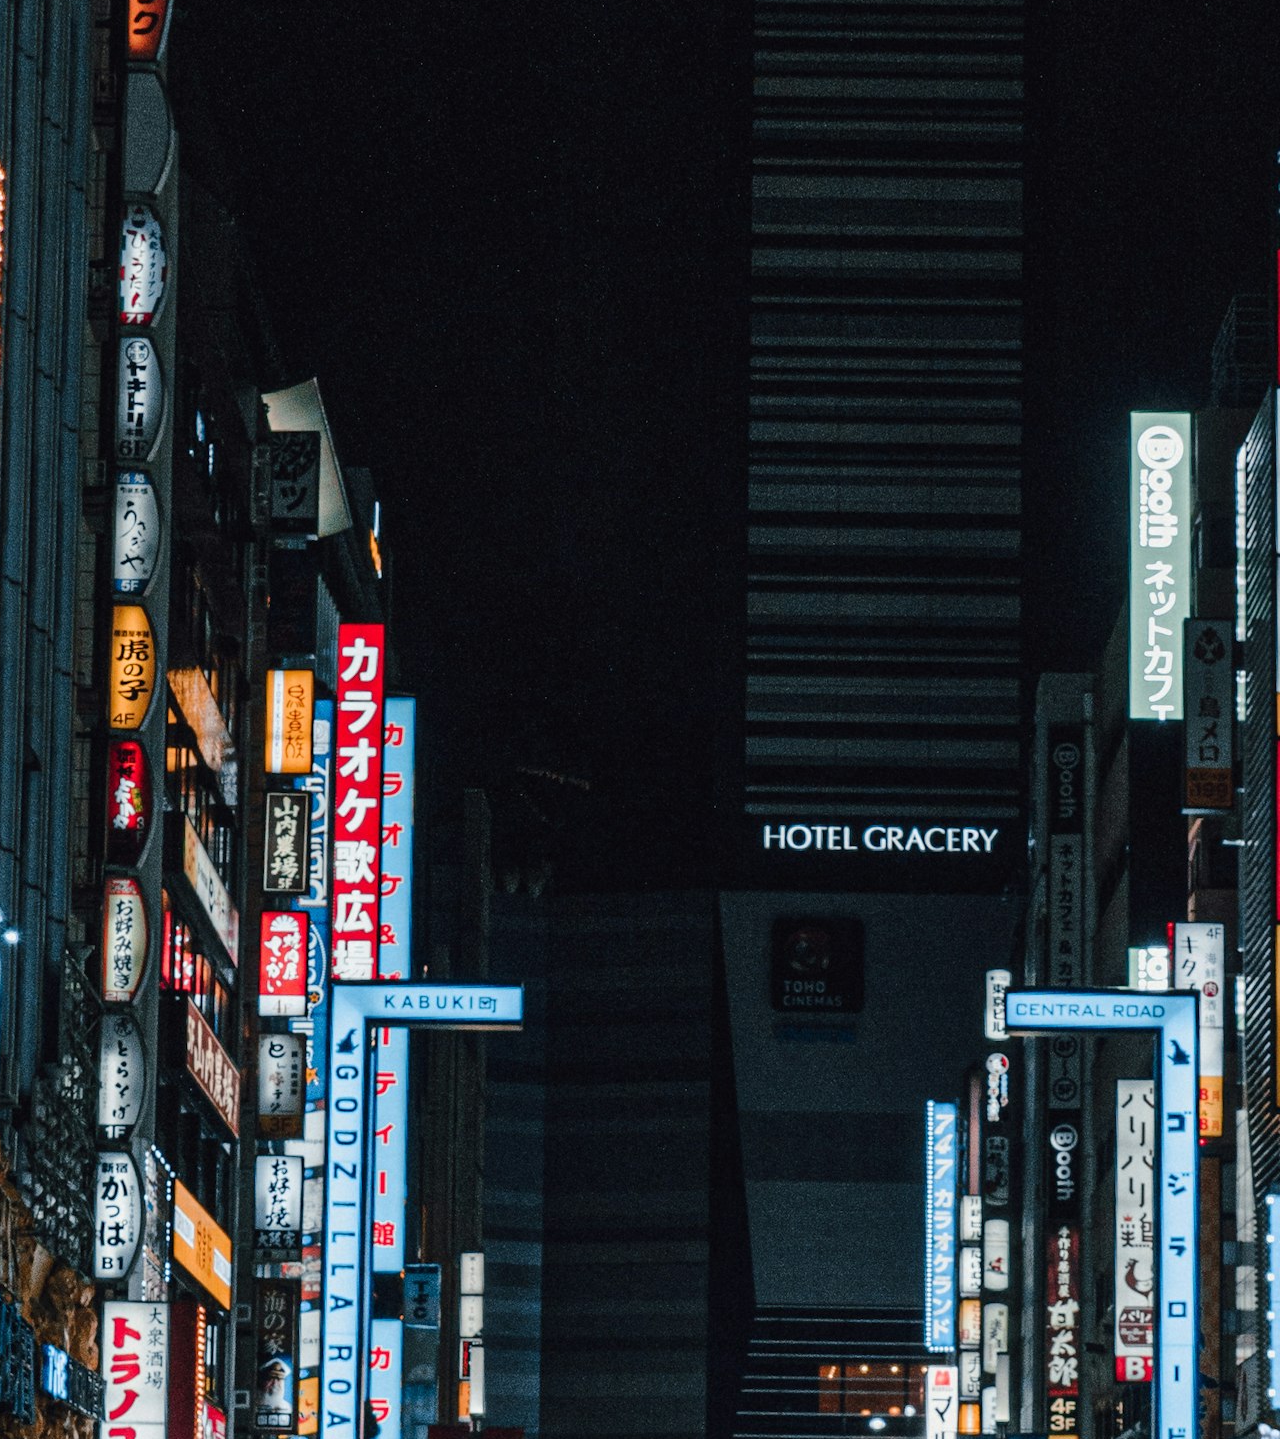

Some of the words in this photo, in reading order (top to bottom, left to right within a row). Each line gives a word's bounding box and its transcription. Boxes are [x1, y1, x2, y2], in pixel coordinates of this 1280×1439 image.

[126, 362, 147, 427] ヤキトリ
[1137, 425, 1184, 548] Booth
[119, 579, 140, 593] 5F
[116, 639, 150, 702] 虎の子
[1144, 560, 1175, 722] ネットカフェ
[112, 712, 136, 726] 4F
[272, 795, 300, 879] 山内農場
[333, 636, 378, 979] カラオケ歌広場
[763, 824, 858, 850] HOTEL
[864, 826, 999, 853] GRACERY
[783, 980, 826, 993] TOHO
[1014, 1002, 1106, 1018] CENTRAL
[1113, 1003, 1166, 1019] ROAD
[933, 1114, 955, 1180] 747
[99, 1179, 129, 1247] かっぱ
[329, 1064, 360, 1311] GODZILLA
[101, 1256, 124, 1270] B1
[933, 1188, 954, 1340] カラオケランド
[143, 1306, 164, 1391] 大衆酒場
[1050, 1397, 1076, 1413] 4F
[1050, 1415, 1076, 1431] 3F
